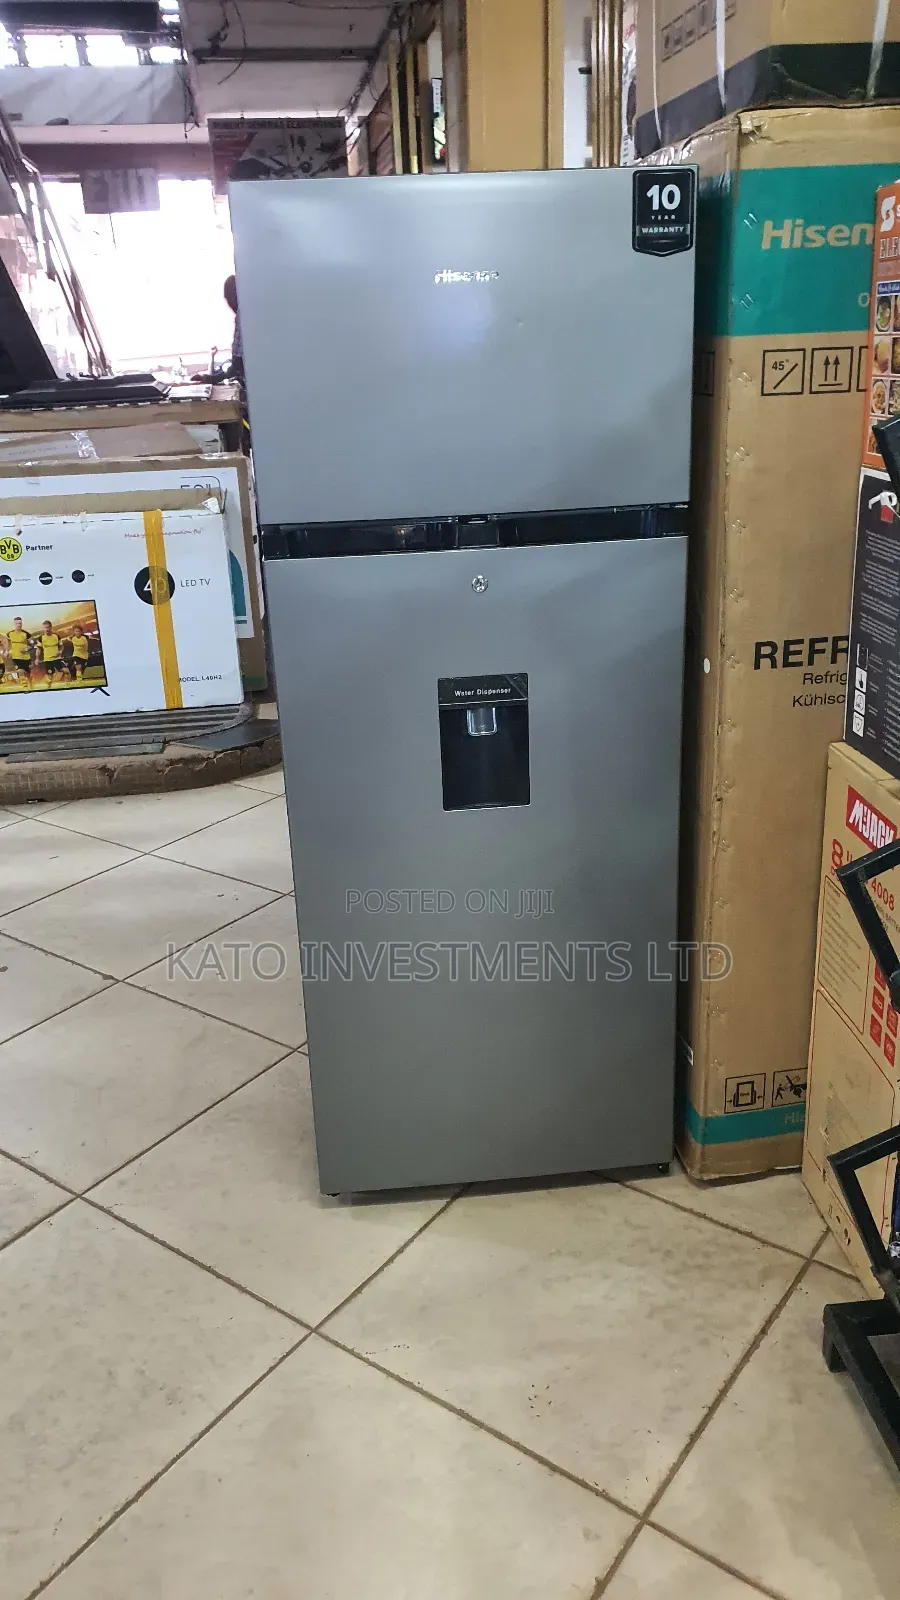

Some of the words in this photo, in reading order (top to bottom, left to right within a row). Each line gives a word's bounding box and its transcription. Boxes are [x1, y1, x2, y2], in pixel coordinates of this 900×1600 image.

[646, 184, 681, 211] 10
[641, 226, 684, 234] WARRANTY
[761, 218, 874, 249] Hisen
[25, 544, 54, 552] Partner
[180, 579, 198, 588] LED
[200, 578, 211, 586] TV
[753, 635, 850, 671] REFR
[476, 688, 511, 696] Dispenser
[832, 838, 844, 869] 8
[871, 877, 895, 912] 4008
